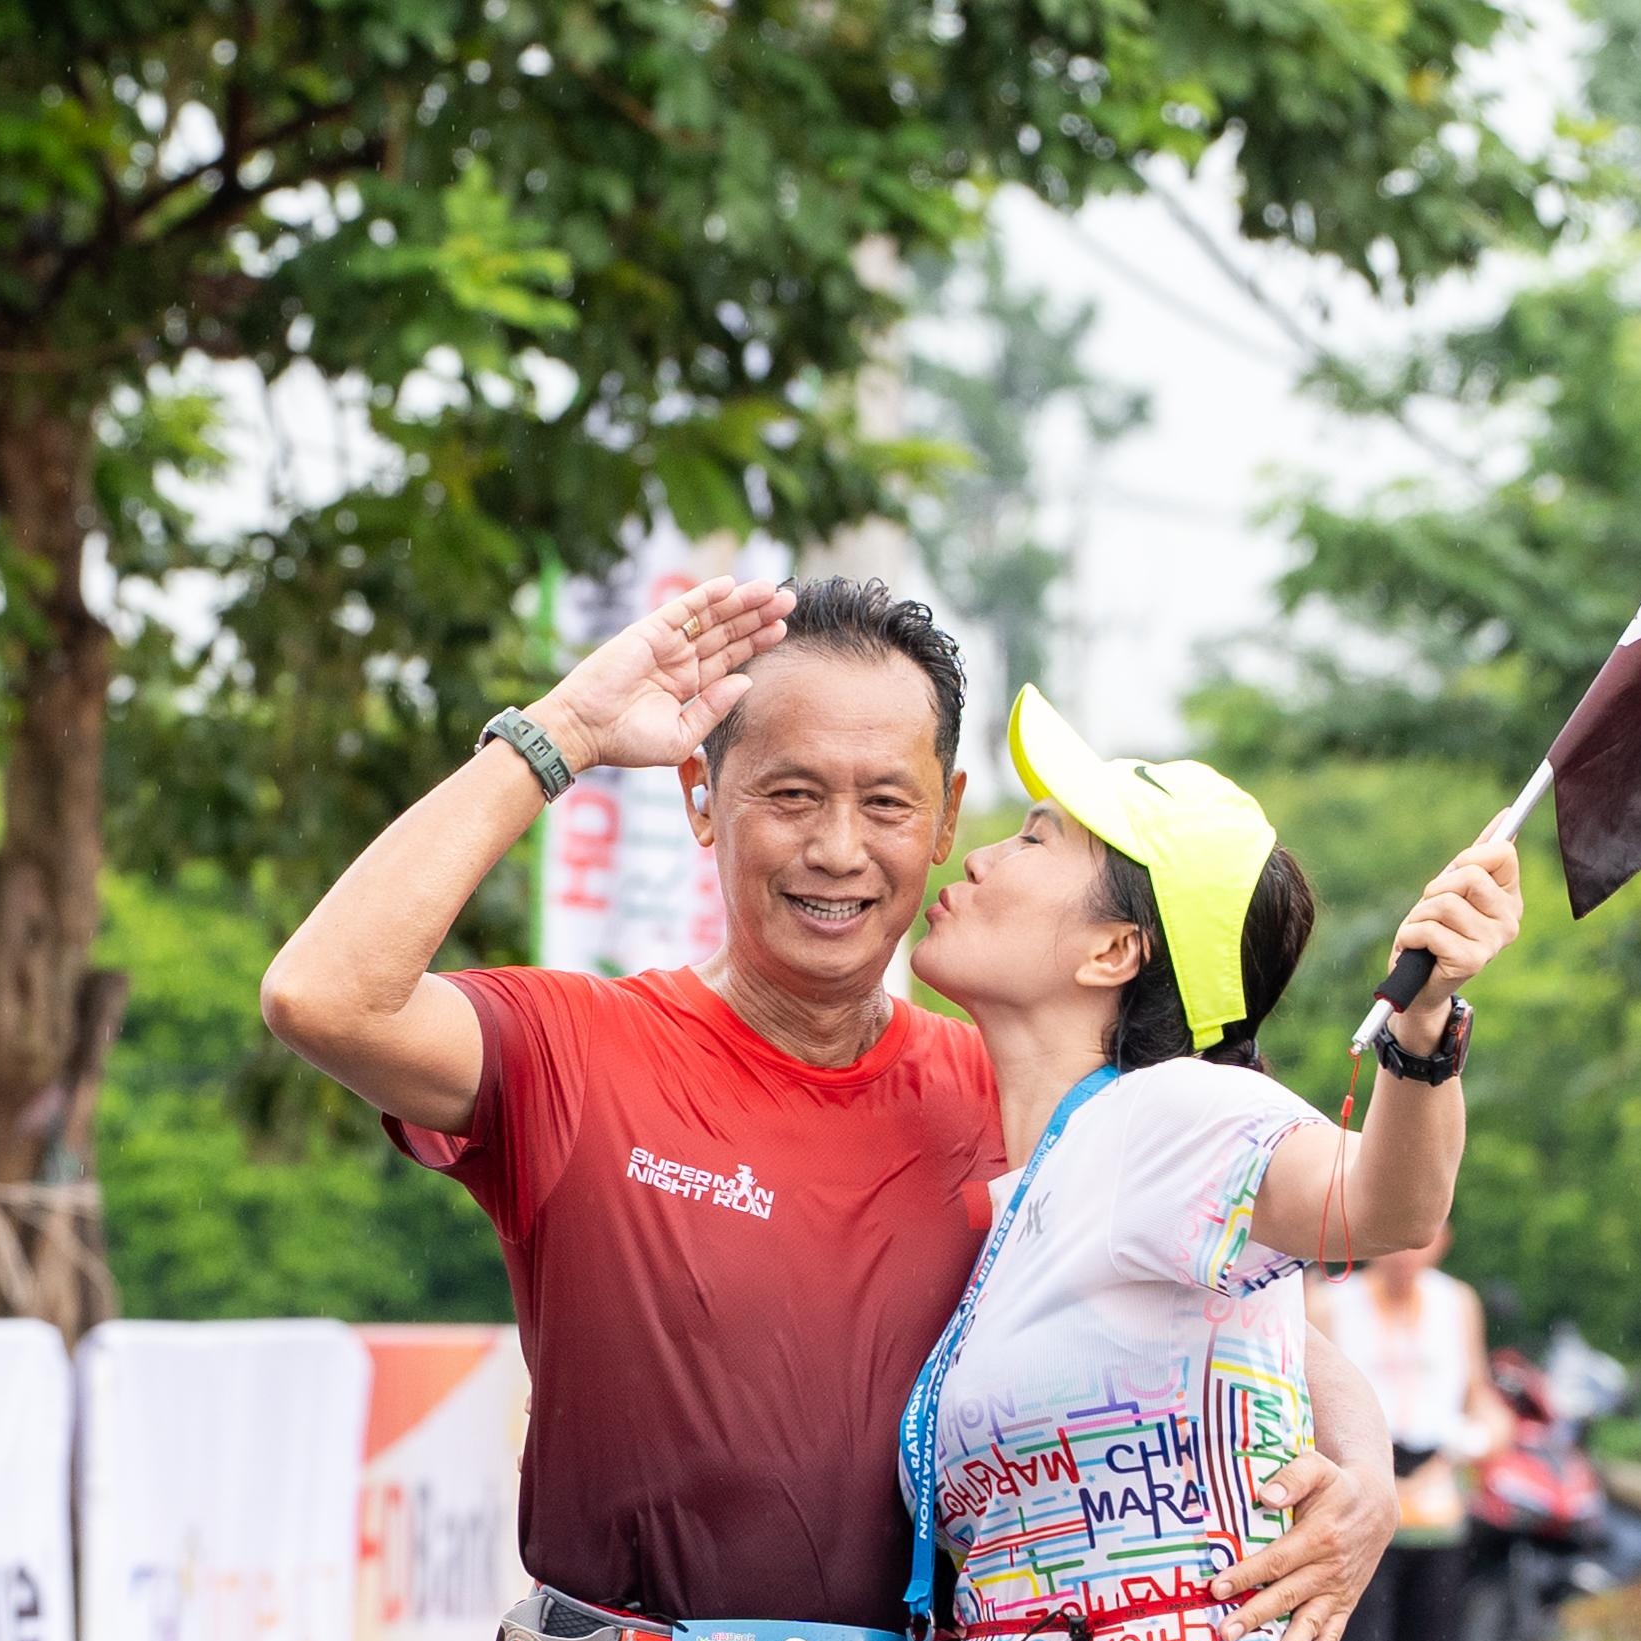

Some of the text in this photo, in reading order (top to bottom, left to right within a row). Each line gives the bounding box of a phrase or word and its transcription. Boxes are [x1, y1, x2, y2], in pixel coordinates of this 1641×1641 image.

[626, 1162, 773, 1220] NIGHT RUN
[919, 1411, 935, 1540] MARATHON
